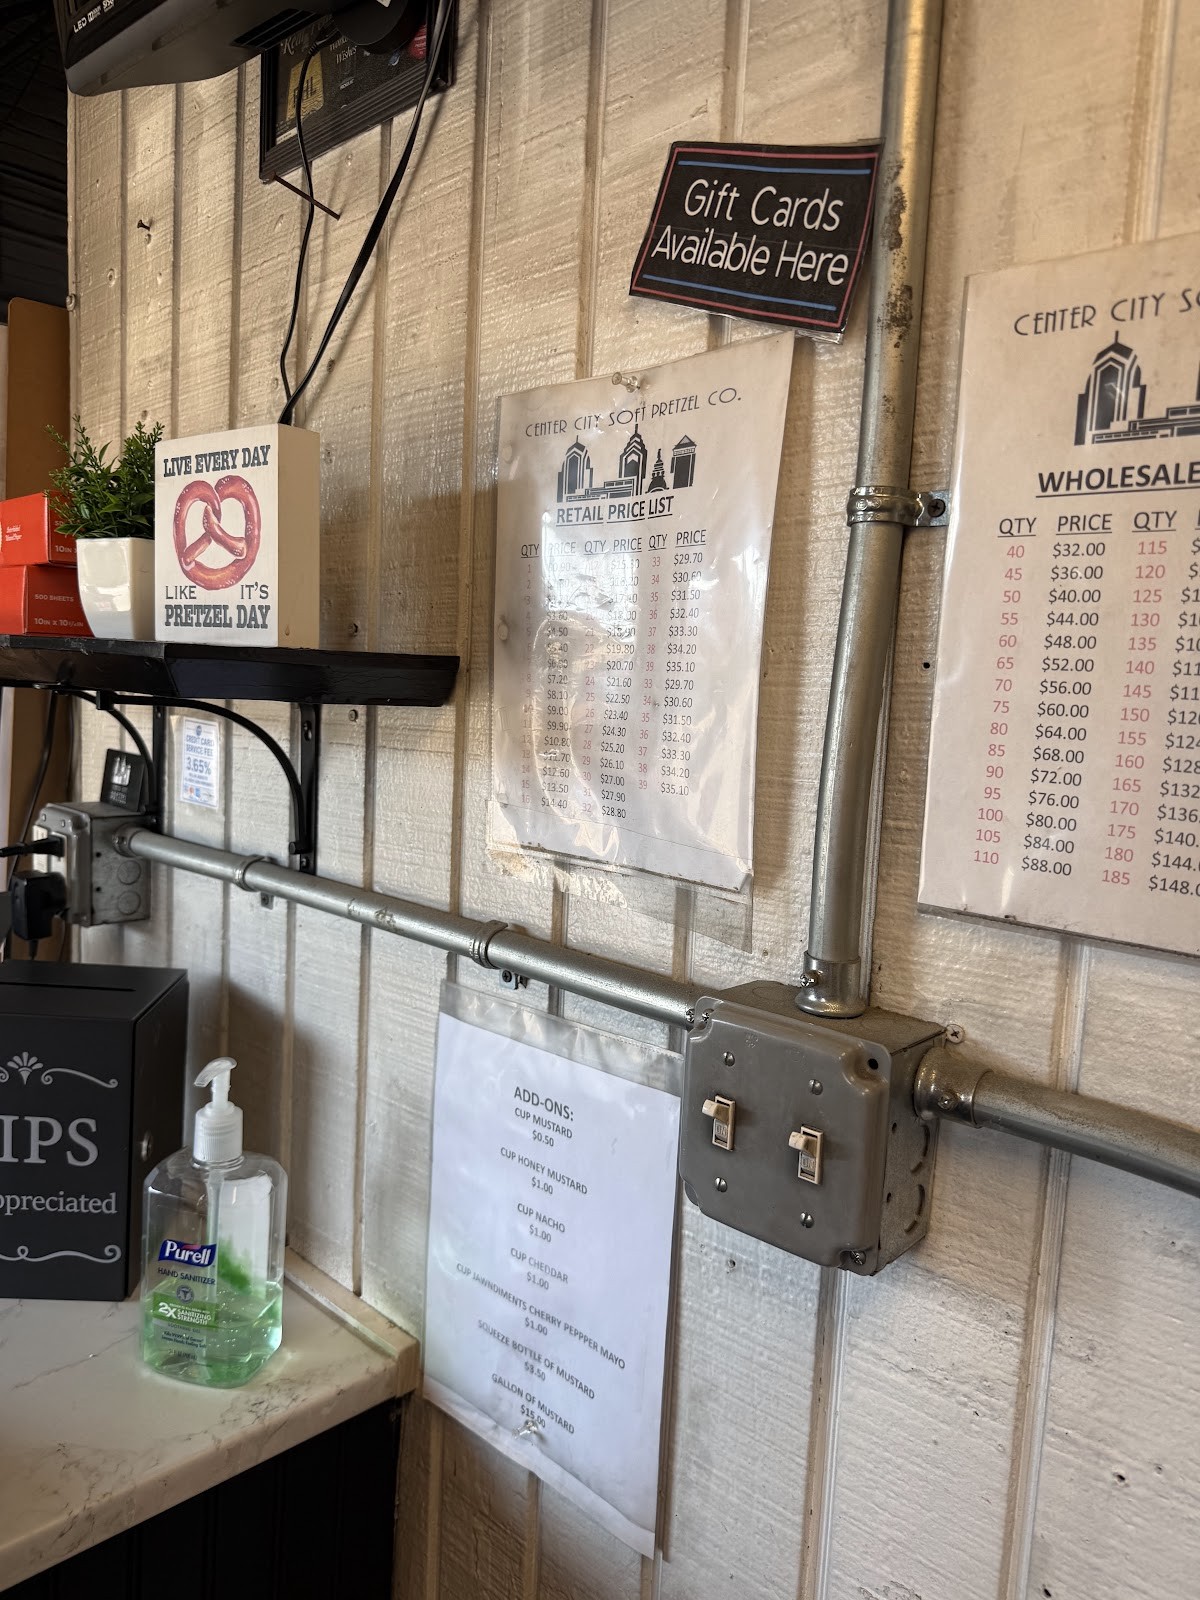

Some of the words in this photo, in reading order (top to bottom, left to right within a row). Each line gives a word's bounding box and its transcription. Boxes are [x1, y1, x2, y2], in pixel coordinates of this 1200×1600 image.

[73, 16, 88, 33] LED
[684, 178, 740, 221] Gift
[751, 186, 844, 232] Cards
[651, 225, 771, 276] Available
[775, 240, 849, 286] Here
[1014, 305, 1097, 336] CENTER
[1110, 293, 1165, 322] CITY
[525, 420, 567, 438] CENTER
[574, 413, 601, 431] CITY
[608, 405, 646, 427] SOFT
[651, 395, 700, 419] PRETZEL
[707, 387, 742, 406] CO.
[163, 455, 192, 477] LIVE
[195, 448, 239, 474] EVERY
[241, 444, 271, 468] DAY
[1038, 461, 1200, 494] WHOLESALE
[556, 505, 604, 524] RETAIL
[607, 501, 645, 520] PRICE
[648, 495, 674, 517] LIST
[998, 517, 1037, 536] QTY
[1057, 513, 1113, 532] PRICE
[1133, 510, 1178, 531] QTY
[521, 543, 540, 557] QTY
[584, 540, 607, 553] QTY
[613, 537, 643, 551] PRICE
[649, 533, 668, 549] QTY
[676, 529, 707, 545] PRICE
[1007, 545, 1025, 558] 40
[1053, 542, 1106, 559] $32.00
[1138, 540, 1167, 555] 115
[652, 556, 661, 567] 33
[673, 552, 703, 567] $29.70
[1004, 567, 1022, 581] 45
[1050, 565, 1103, 582] $36.00
[1135, 564, 1166, 579] 120
[49, 594, 74, 602] SHEETS
[166, 585, 197, 600] LIKE
[240, 581, 269, 600] IT'S
[650, 592, 659, 602] 35
[671, 589, 701, 602] $31.50
[1003, 590, 1021, 603] 50
[1049, 588, 1101, 605] $40.00
[1133, 589, 1162, 603] 125
[165, 604, 232, 629] PRETZEL
[236, 604, 271, 629] DAY
[649, 610, 658, 620] 36
[669, 608, 700, 620] $32.40
[1000, 612, 1018, 625] 55
[1046, 611, 1099, 628] $44.00
[1130, 613, 1160, 627] 130
[648, 627, 657, 637] 37
[668, 625, 698, 638] $33.30
[647, 644, 656, 655] 38
[667, 643, 697, 656] $34.20
[999, 635, 1017, 648] 60
[1044, 634, 1097, 651] $48.00
[1128, 637, 1157, 651] 135
[646, 662, 654, 672] 39
[666, 660, 696, 673] $35.10
[996, 657, 1014, 670] 65
[1041, 656, 1094, 673] $52.00
[1126, 660, 1155, 675] 140
[644, 679, 653, 689] 33
[664, 678, 694, 691] $29.70
[995, 679, 1012, 692] 70
[1039, 678, 1092, 695] $56.00
[1123, 684, 1152, 699] 145
[643, 695, 651, 706] 34
[663, 695, 693, 709] $30.60
[993, 700, 1010, 714] 75
[1037, 701, 1089, 718] $60.00
[1120, 707, 1150, 722] 150
[641, 712, 650, 723] 35
[662, 713, 692, 726] $31.50
[639, 729, 649, 740] 36
[662, 731, 692, 744] $32.40
[990, 723, 1008, 735] 80
[1035, 723, 1087, 741] $64.00
[1118, 731, 1147, 746] 155
[638, 746, 648, 757] 37
[661, 748, 691, 762] $33.30
[988, 744, 1006, 757] 85
[1032, 746, 1085, 764] $68.00
[1115, 754, 1145, 769] 160
[186, 756, 212, 776] 3.65%
[638, 763, 648, 773] 38
[661, 766, 690, 779] $34.20
[638, 780, 648, 790] 39
[660, 783, 689, 797] $35.10
[986, 766, 1004, 778] 90
[1030, 768, 1082, 787] $72.00
[1113, 778, 1142, 793] 165
[984, 787, 1001, 800] 95
[1028, 790, 1080, 809] $76.00
[1110, 801, 1139, 816] 170
[977, 808, 1004, 822] 100
[1026, 812, 1077, 831] $80.00
[1107, 824, 1136, 839] 175
[975, 829, 1001, 843] 105
[1023, 834, 1075, 854] $84.00
[1105, 847, 1134, 862] 180
[974, 850, 1000, 864] 110
[1021, 856, 1072, 876] $88.00
[1102, 870, 1131, 885] 185
[514, 1086, 574, 1122] ADD-ONS:
[514, 1107, 531, 1121] CUP
[532, 1114, 573, 1139] MUSTARD
[532, 1129, 555, 1147] $0.50
[500, 1147, 517, 1160] CUP
[518, 1154, 546, 1174] HONEY
[547, 1168, 588, 1195] MUSTARD
[531, 1176, 554, 1195] $1.00
[517, 1203, 534, 1216] CUP
[535, 1211, 566, 1233] NACHO
[529, 1224, 552, 1243] $1.00
[165, 1240, 211, 1265] Purell
[510, 1247, 527, 1262] CUP
[528, 1256, 569, 1284] CHEDDAR
[158, 1266, 179, 1278] HAND
[180, 1270, 216, 1286] SANITIZER
[526, 1271, 550, 1290] $1.00
[159, 1302, 177, 1319] 2X
[456, 1263, 471, 1277] CUP
[472, 1271, 527, 1311] JAWNDIMENTS
[529, 1305, 562, 1328] CHERRY
[563, 1322, 599, 1352] PEPPPER
[600, 1345, 626, 1369] MAYO
[524, 1317, 548, 1336] $1.00
[478, 1319, 510, 1346] SQUEEZE
[512, 1340, 542, 1363] BOTTLE
[544, 1357, 554, 1370] OF
[556, 1365, 595, 1400] MUSTARD
[524, 1361, 546, 1382] $3.50
[491, 1373, 523, 1397] GALLON
[525, 1392, 536, 1405] OF
[537, 1399, 575, 1434] MUSTARD
